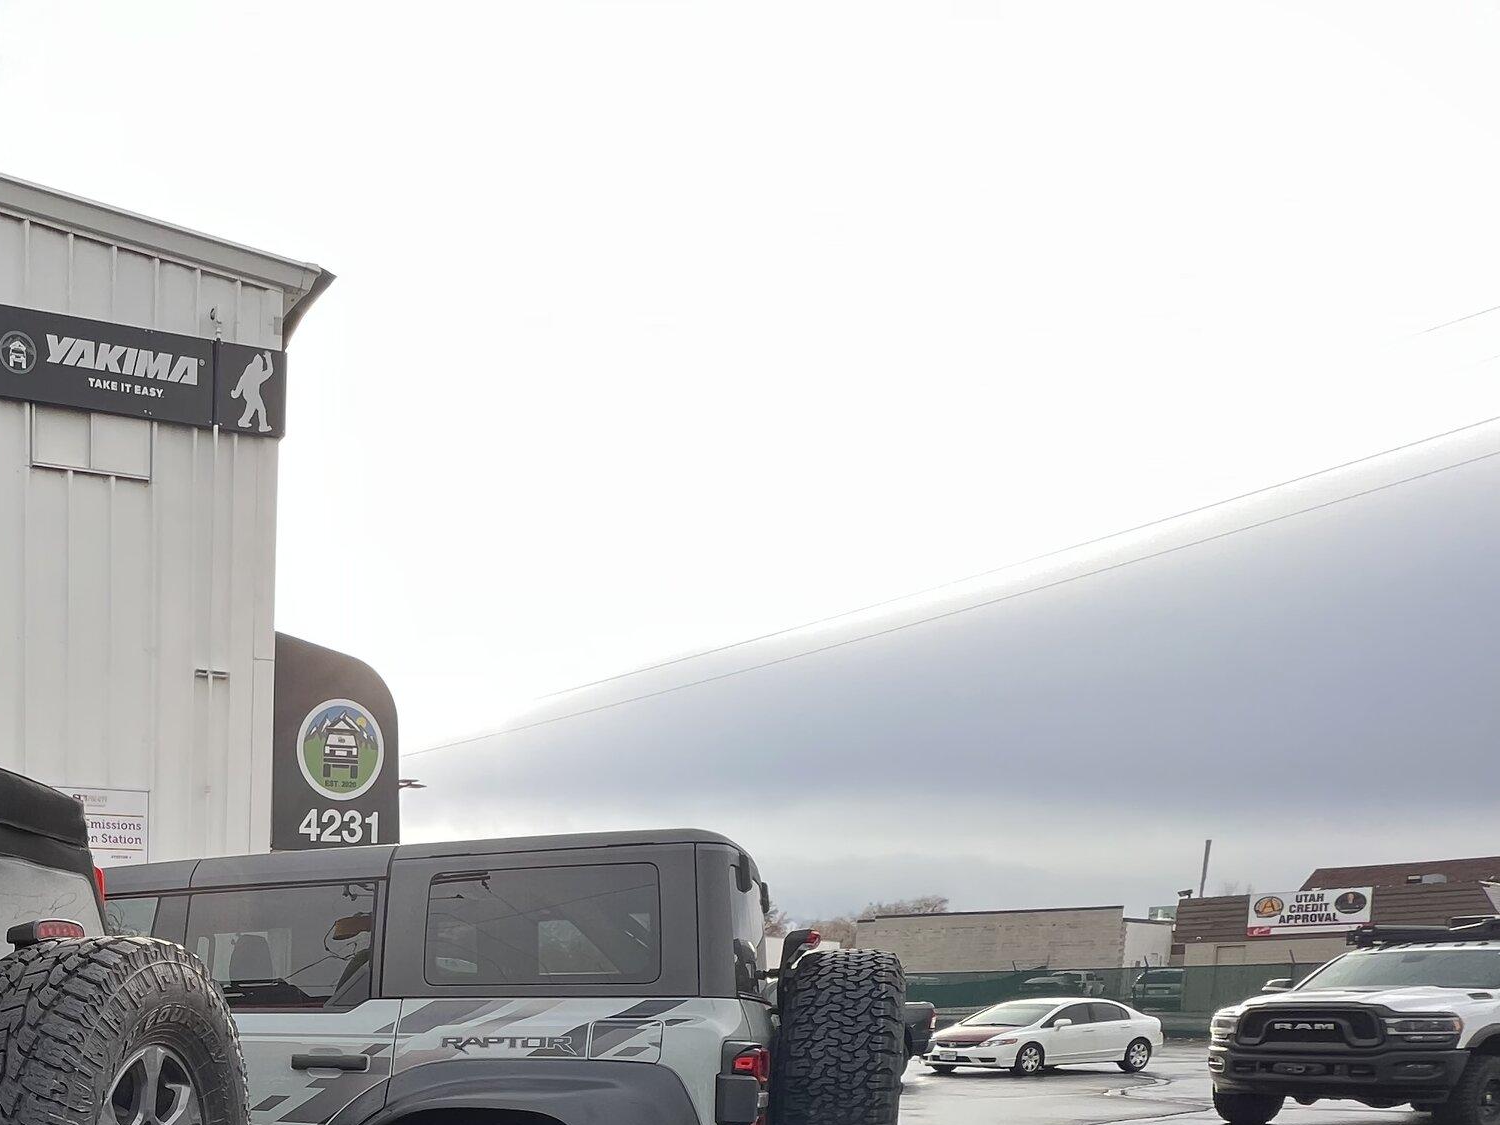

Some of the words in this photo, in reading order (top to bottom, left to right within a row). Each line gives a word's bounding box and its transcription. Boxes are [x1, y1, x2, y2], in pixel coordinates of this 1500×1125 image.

[46, 333, 198, 386] YAKIMA
[88, 377, 118, 392] TAKE
[121, 382, 132, 394] IT
[299, 808, 379, 843] 4231
[101, 833, 142, 845] Station
[1295, 893, 1325, 904] UTAH
[1288, 902, 1330, 914] CREDIT
[1278, 912, 1339, 924] APPROVAL
[441, 1036, 578, 1056] RAPTOR
